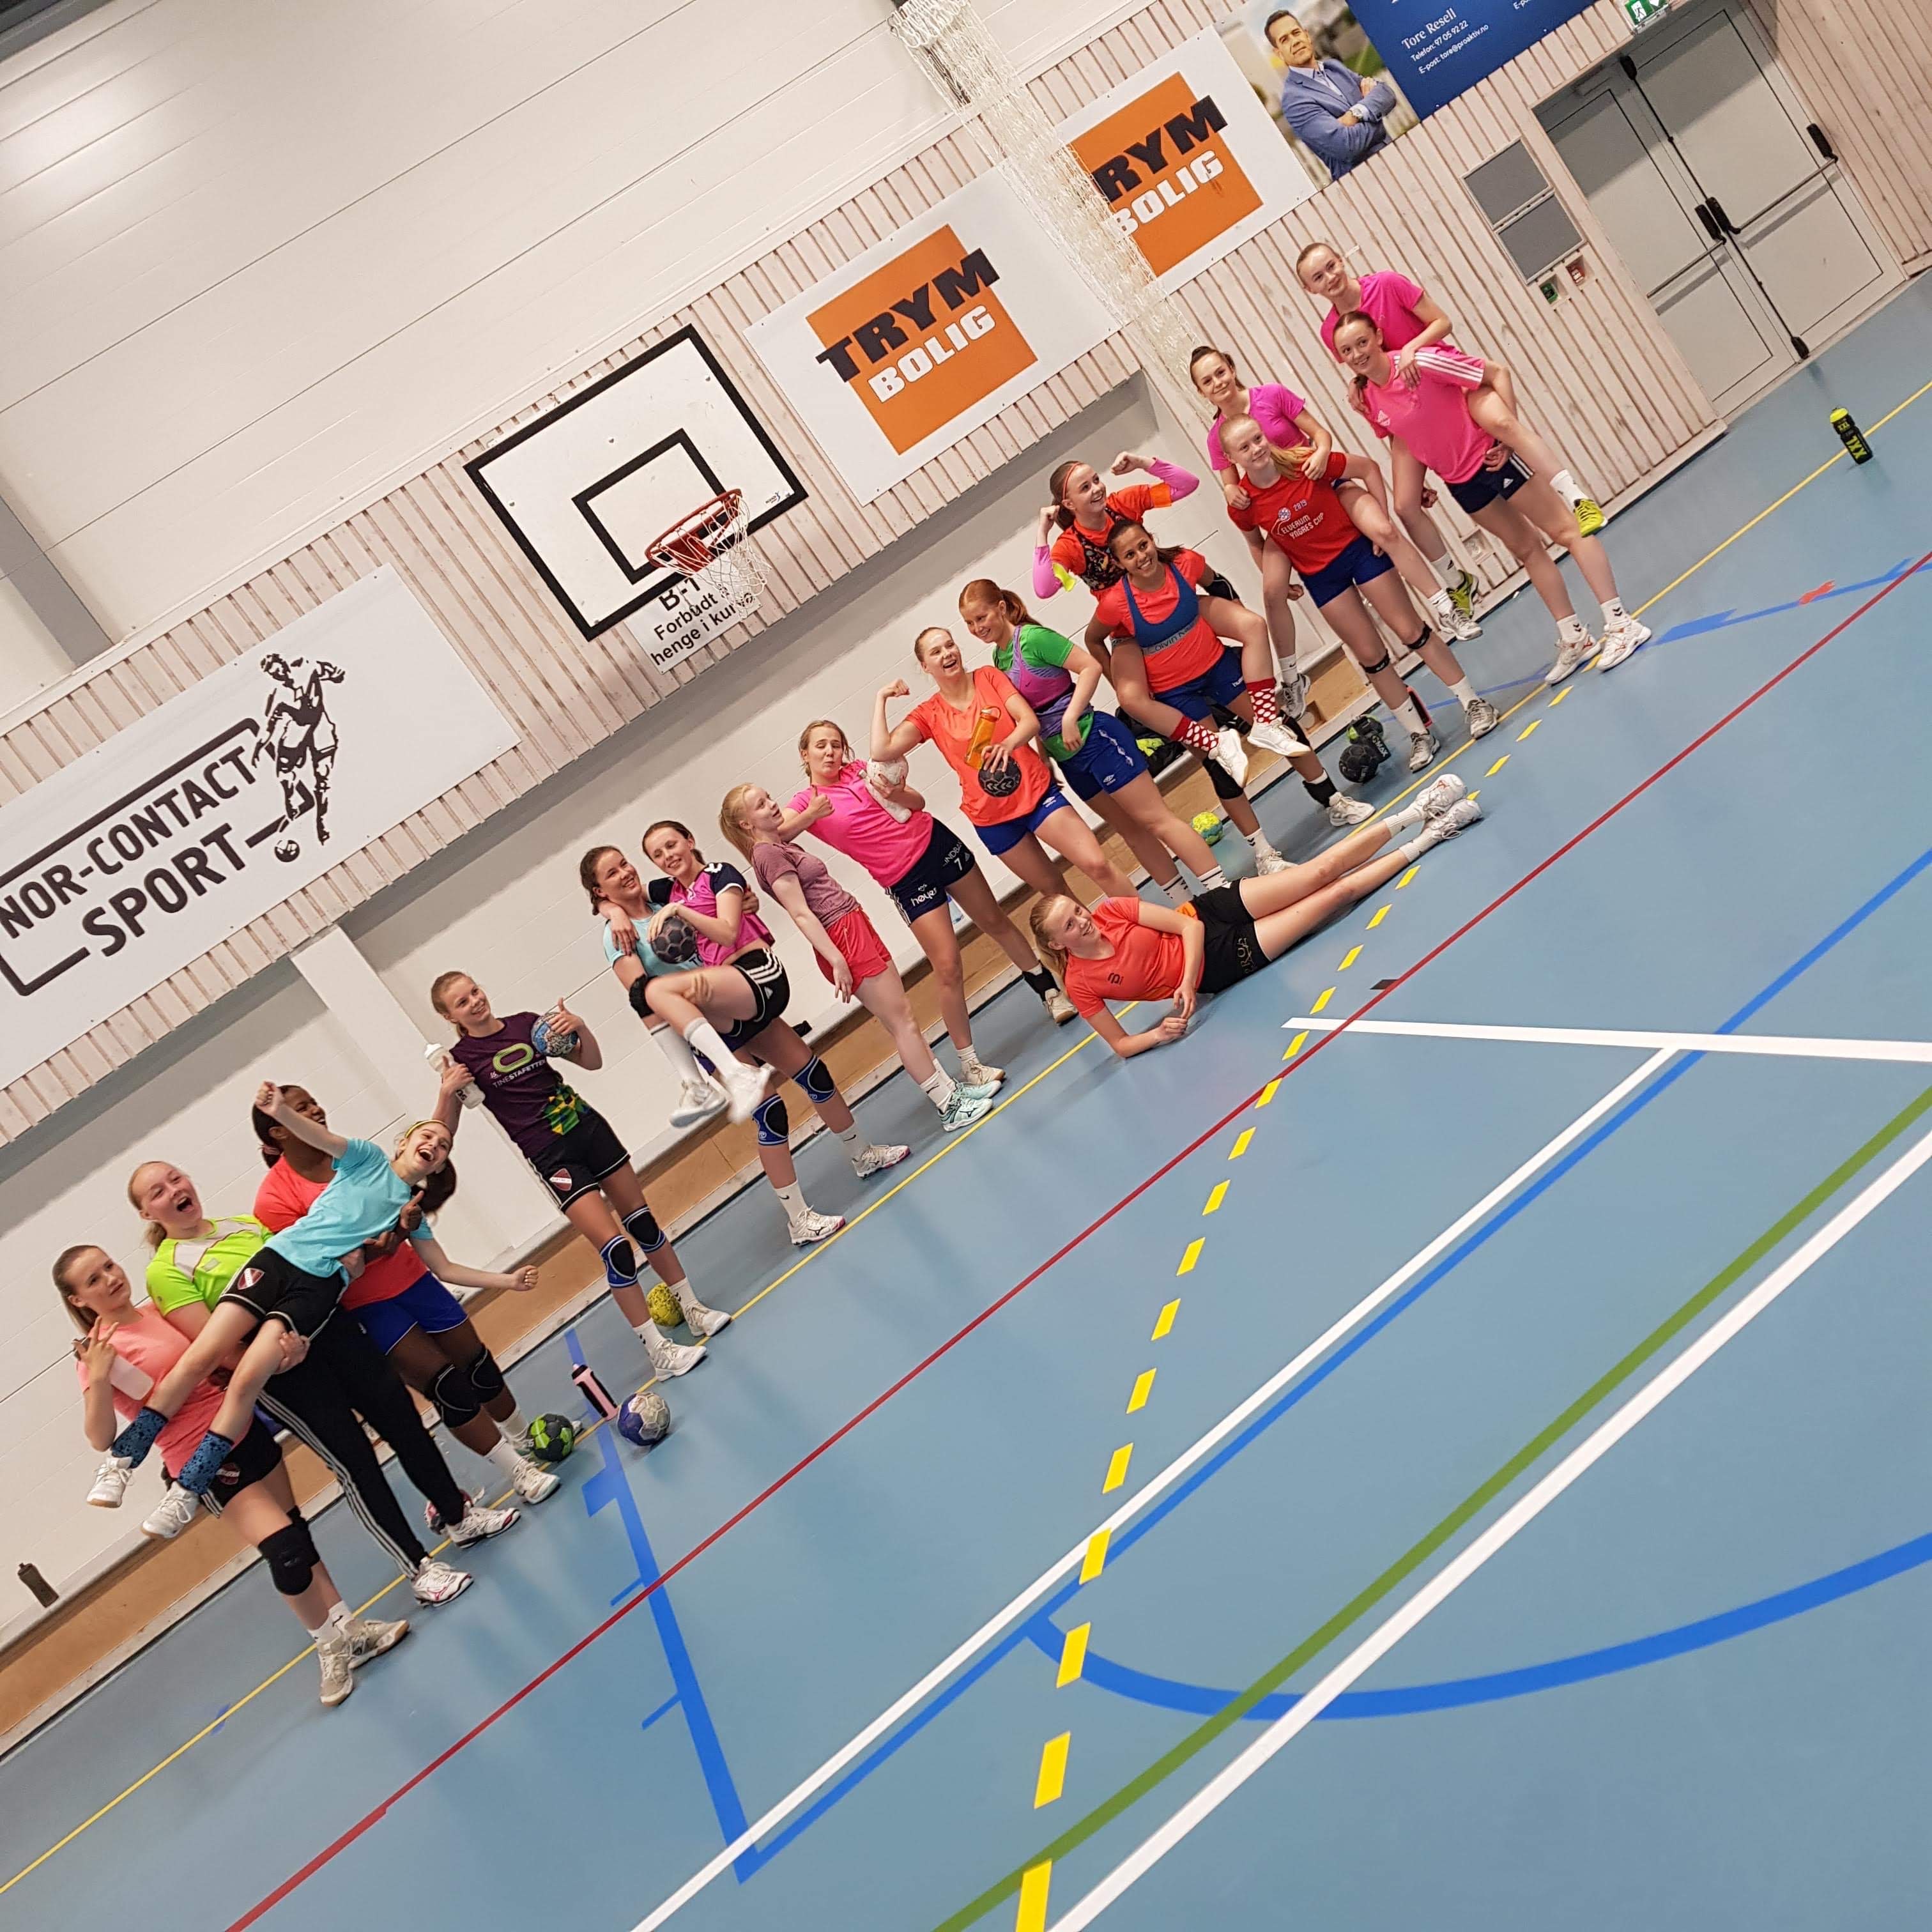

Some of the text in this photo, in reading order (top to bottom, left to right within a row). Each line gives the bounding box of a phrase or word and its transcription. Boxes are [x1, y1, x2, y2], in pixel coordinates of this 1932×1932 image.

[1401, 7, 1457, 49] Tore Resell
[1411, 20, 1469, 62] Telefon: 97 05 92 22
[1439, 24, 1489, 60] tore@proaktiv.no
[1090, 95, 1228, 203] RYM
[815, 247, 1000, 383] TRYM
[867, 305, 997, 404] BOLIG
[1280, 514, 1311, 535] ELVERUM
[1313, 512, 1324, 525] CUP
[654, 592, 719, 641] Forbudt
[650, 630, 702, 666] henge
[700, 618, 710, 632] i
[0, 746, 256, 939] NOR-CONTACT
[954, 857, 962, 871] 7
[82, 823, 246, 957] SPORT
